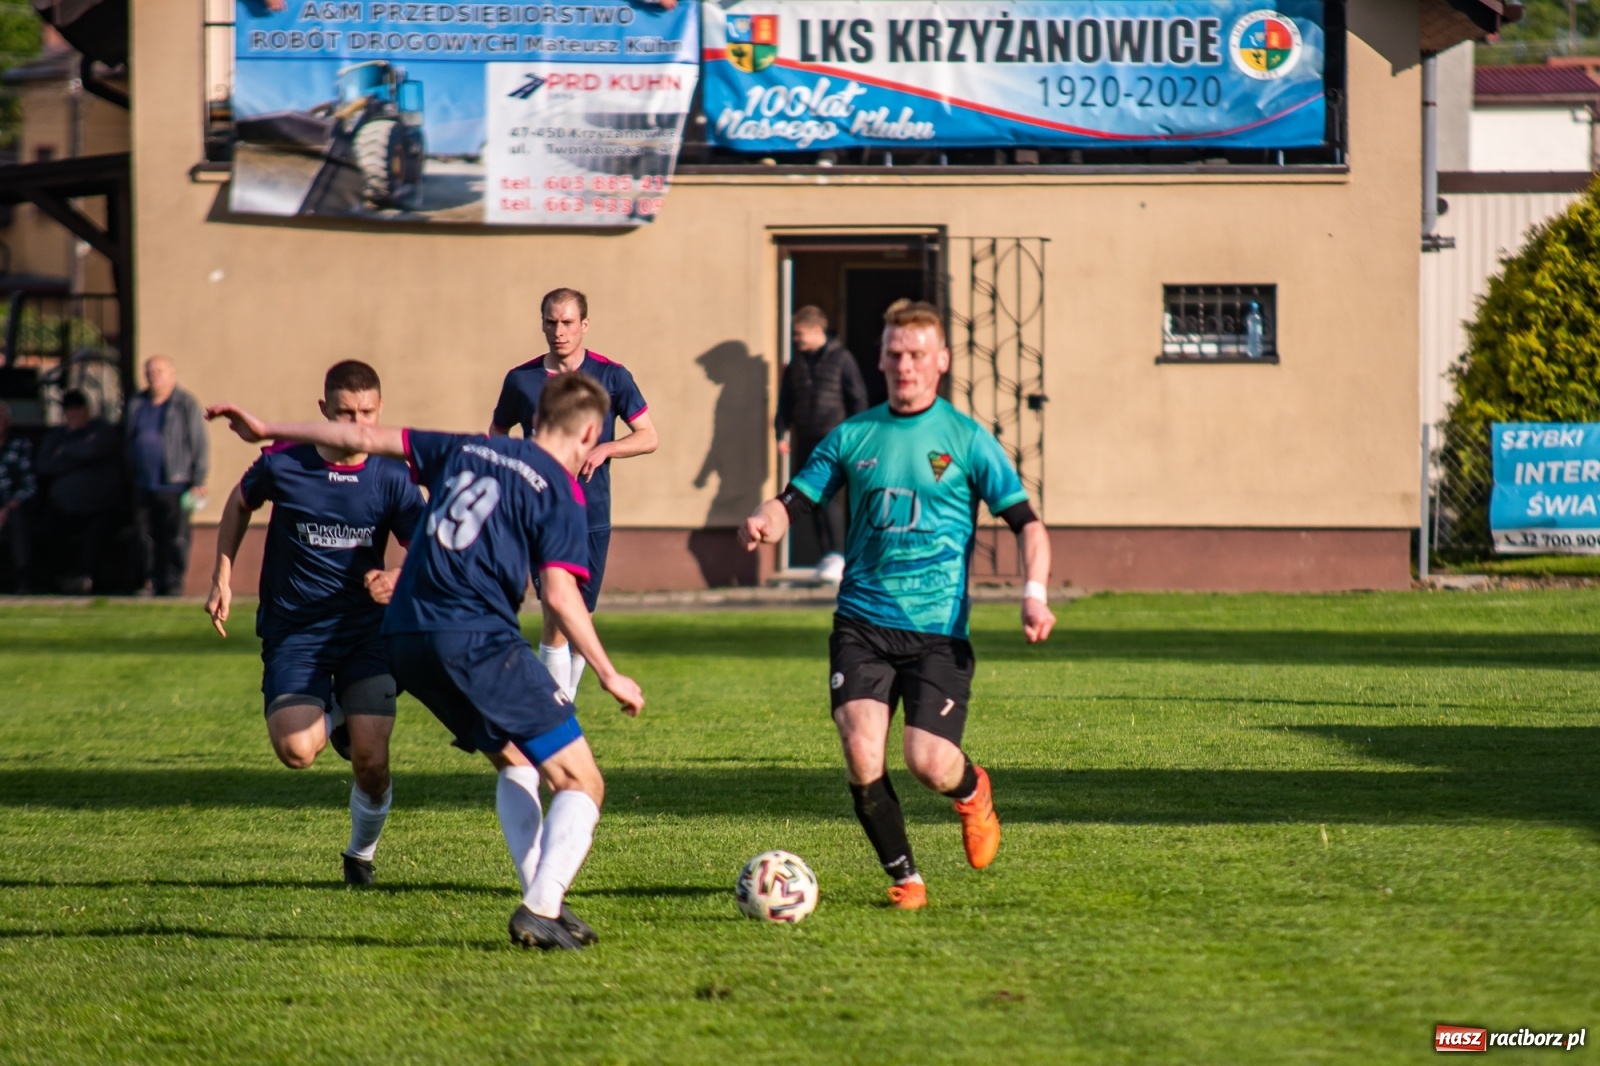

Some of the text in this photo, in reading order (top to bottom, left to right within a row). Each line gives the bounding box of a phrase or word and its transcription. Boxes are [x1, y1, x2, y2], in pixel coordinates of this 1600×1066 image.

[303, 2, 634, 28] A&M PRZEDSIĘBIORSTWO
[252, 29, 341, 50] ROBÓT
[349, 32, 517, 53] DROGOWYCH
[524, 36, 620, 54] Mateusz
[799, 18, 874, 63] LKS
[888, 11, 1220, 64] KRZYŻANOWICE
[547, 73, 682, 91] PRD KUHN
[1038, 75, 1222, 108] 1920-2020
[510, 126, 566, 138] 47-450
[716, 106, 936, 148] Naszego Klubu
[500, 176, 537, 189] tel.
[545, 176, 586, 190] 603
[500, 198, 537, 211] tel.
[545, 197, 586, 212] 663
[1501, 428, 1585, 450] SZYBKI
[1514, 459, 1600, 485] INTER
[1526, 491, 1600, 516] ŚWIA
[1541, 534, 1572, 547] 700
